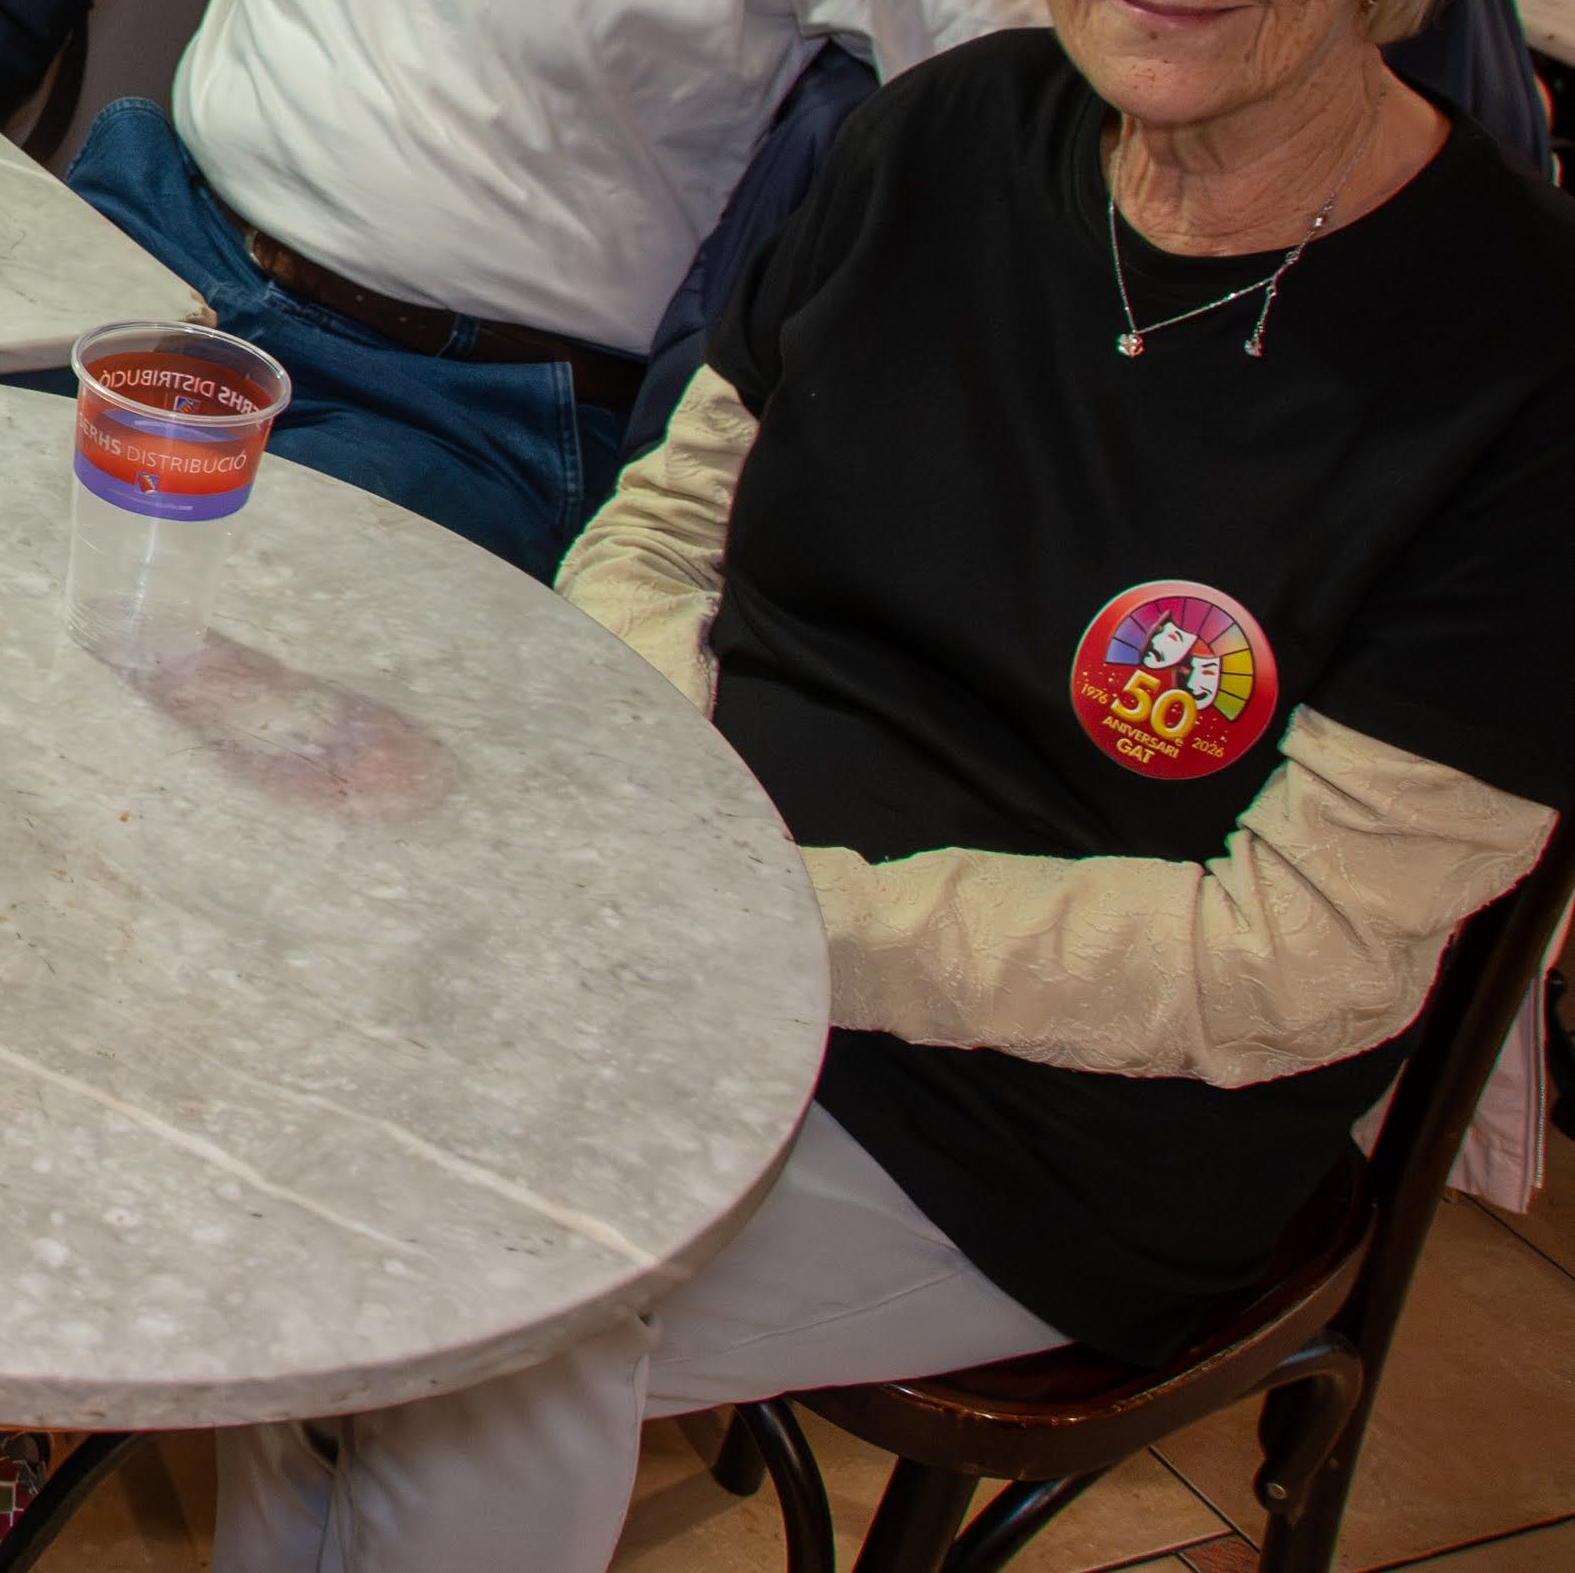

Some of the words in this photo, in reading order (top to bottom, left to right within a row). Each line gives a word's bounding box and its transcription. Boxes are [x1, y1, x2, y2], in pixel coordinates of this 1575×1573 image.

[79, 412, 122, 456] SERHS
[126, 444, 247, 474] DISTRIBUCIÓ
[1080, 683, 1108, 705] 1976
[1110, 669, 1198, 740] 50
[1102, 715, 1180, 759] ANIVERSARI
[1115, 737, 1155, 764] GAT
[1191, 737, 1224, 758] 2026
